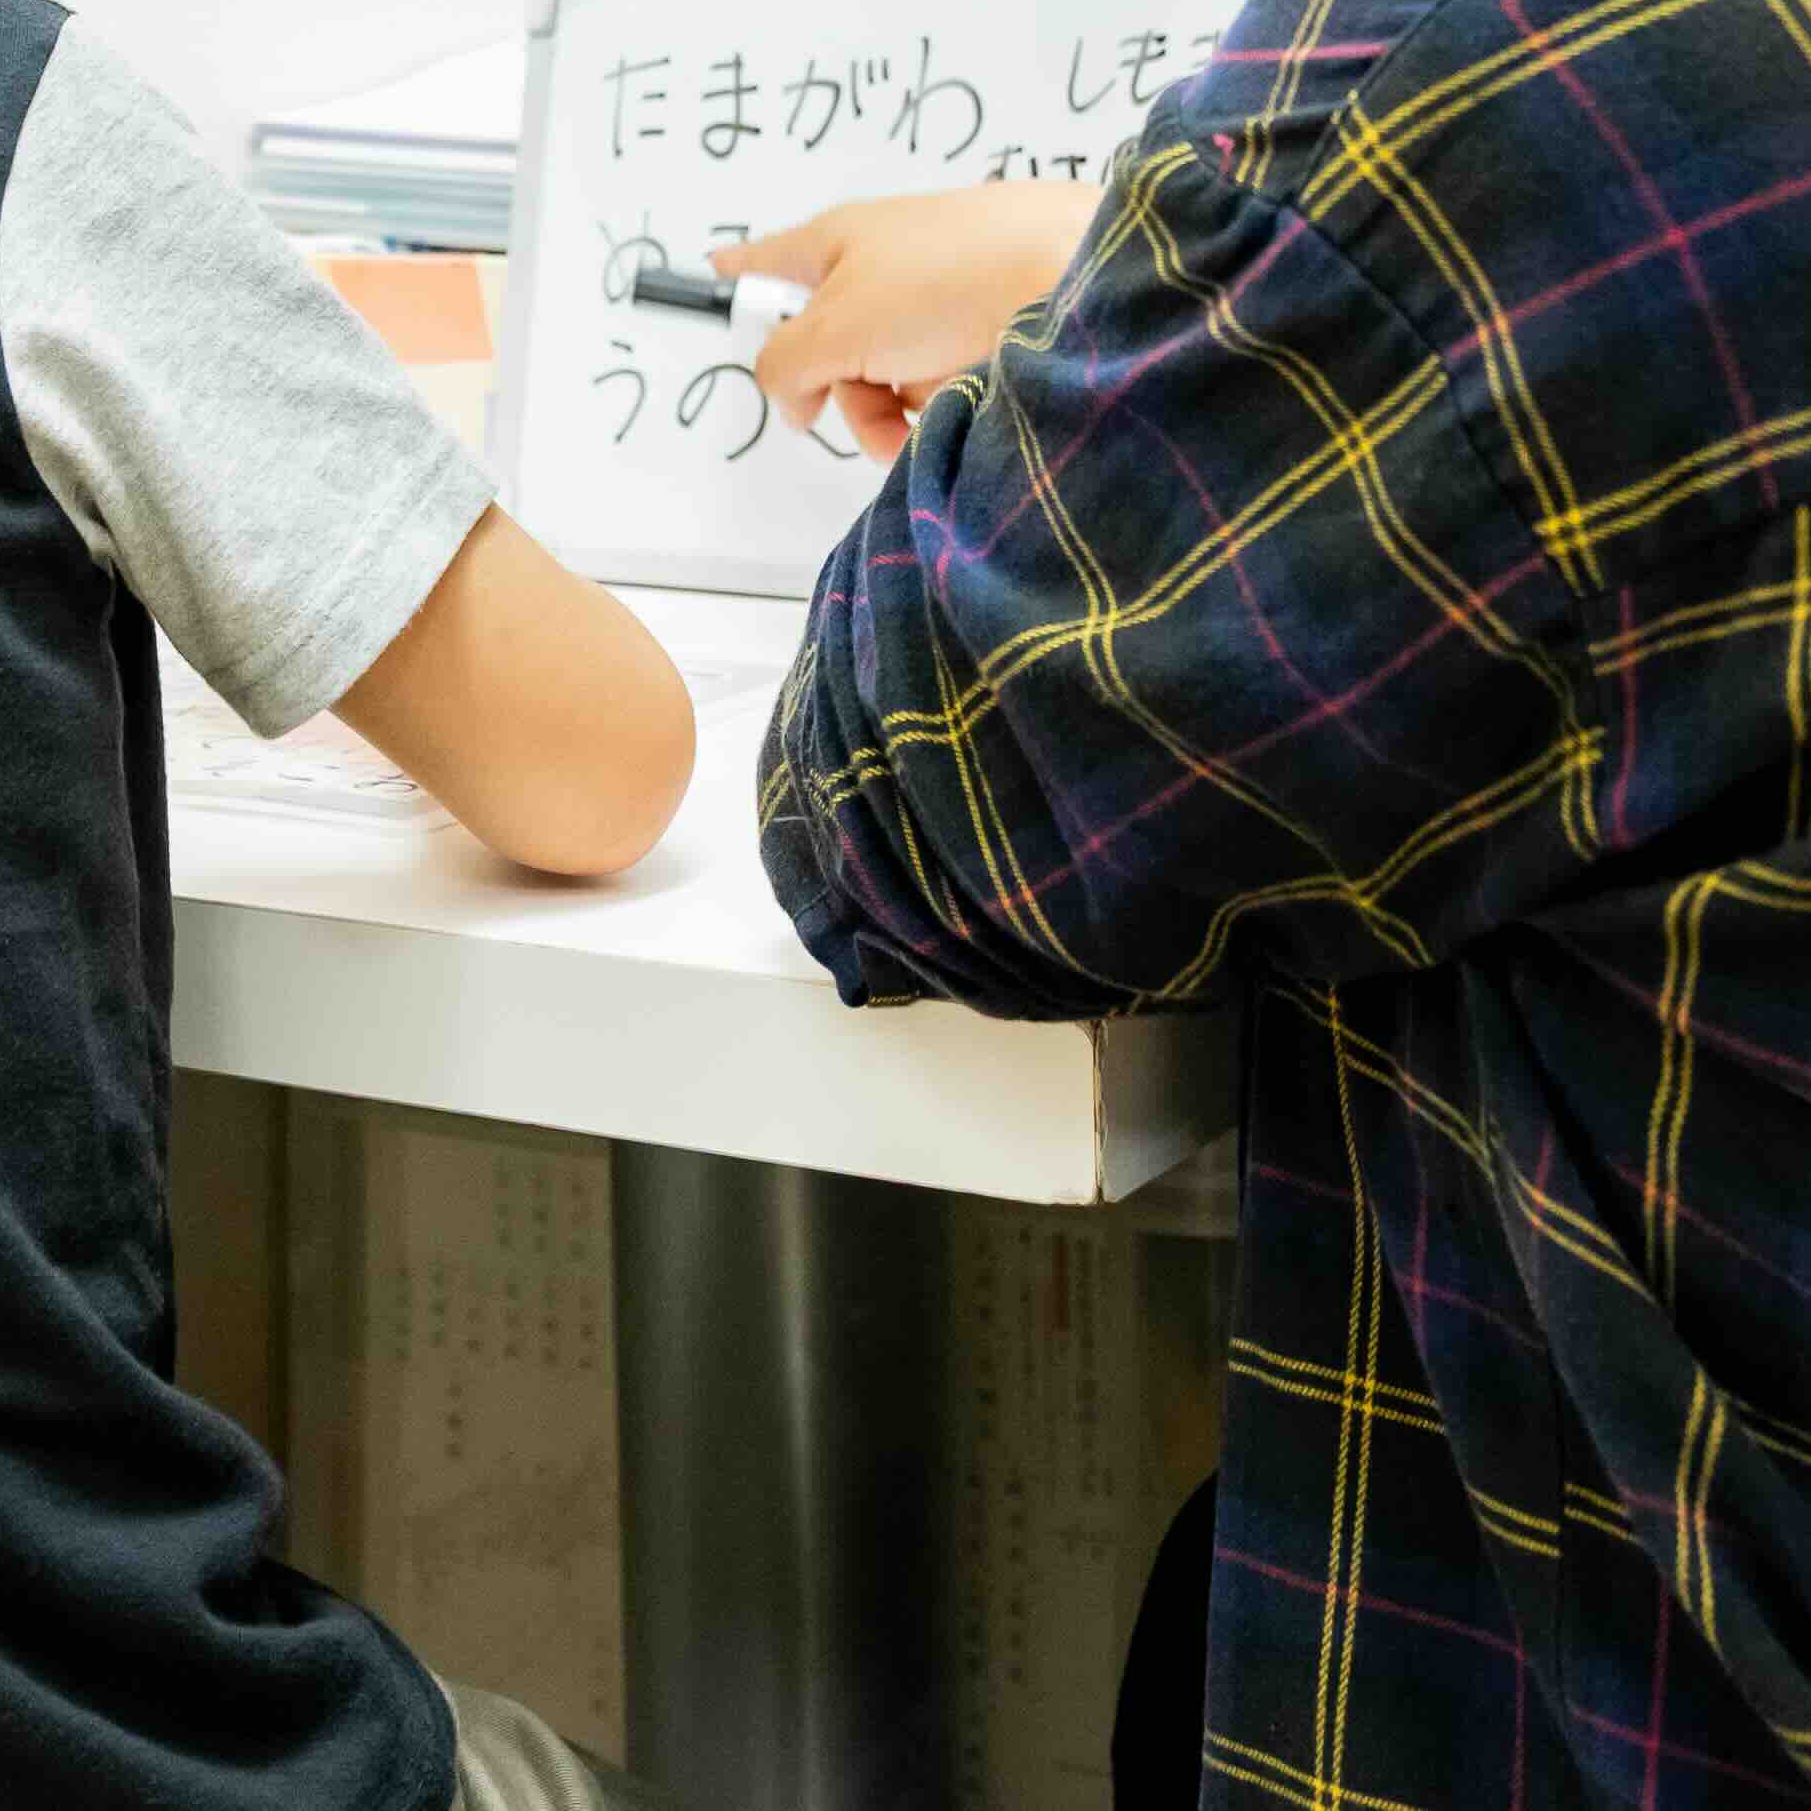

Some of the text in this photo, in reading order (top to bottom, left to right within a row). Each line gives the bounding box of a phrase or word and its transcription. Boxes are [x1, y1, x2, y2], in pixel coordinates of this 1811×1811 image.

[602, 36, 984, 162] たまがわ
[592, 339, 861, 462] うの
